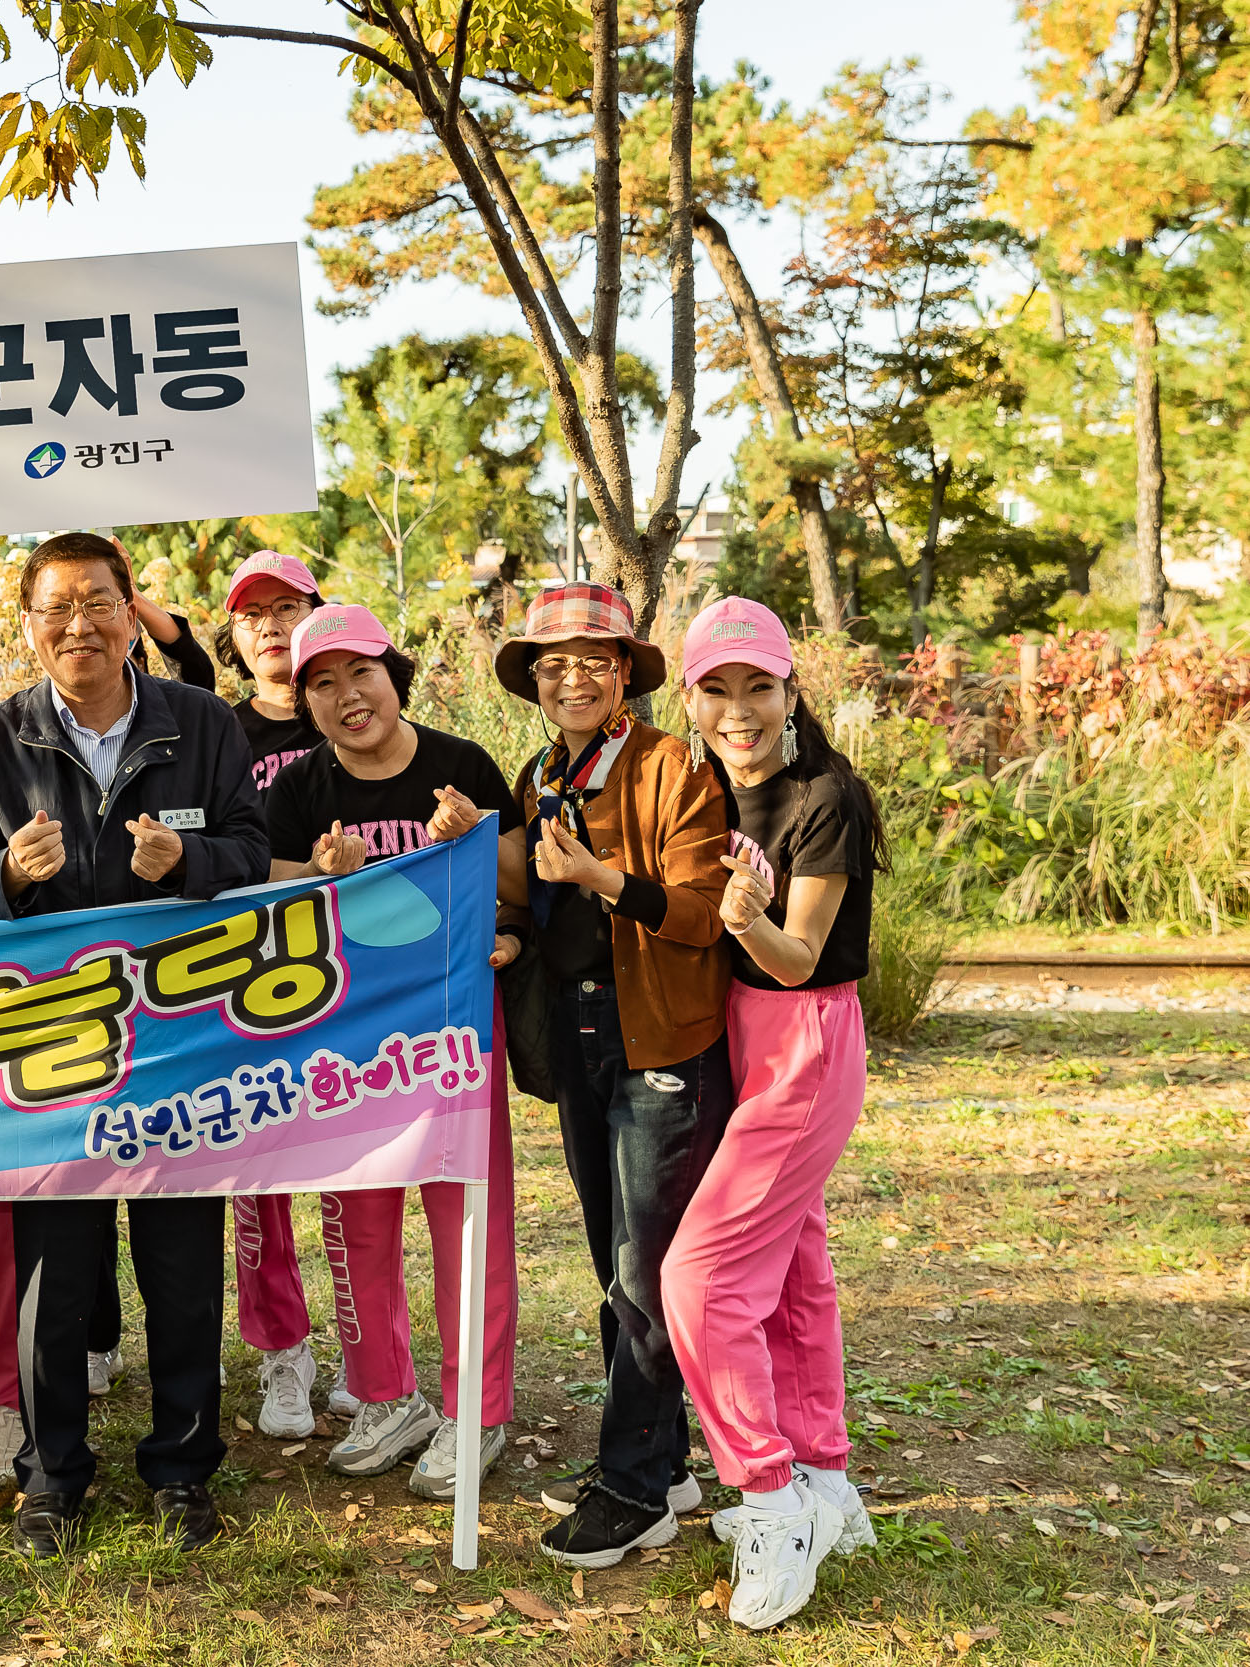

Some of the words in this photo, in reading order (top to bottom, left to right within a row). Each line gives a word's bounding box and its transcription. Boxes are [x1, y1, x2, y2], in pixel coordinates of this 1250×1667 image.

[73, 438, 175, 470] 광진구
[710, 629, 760, 642] CHANCE
[713, 621, 757, 634] BONNE
[92, 1066, 297, 1161] 성인군자
